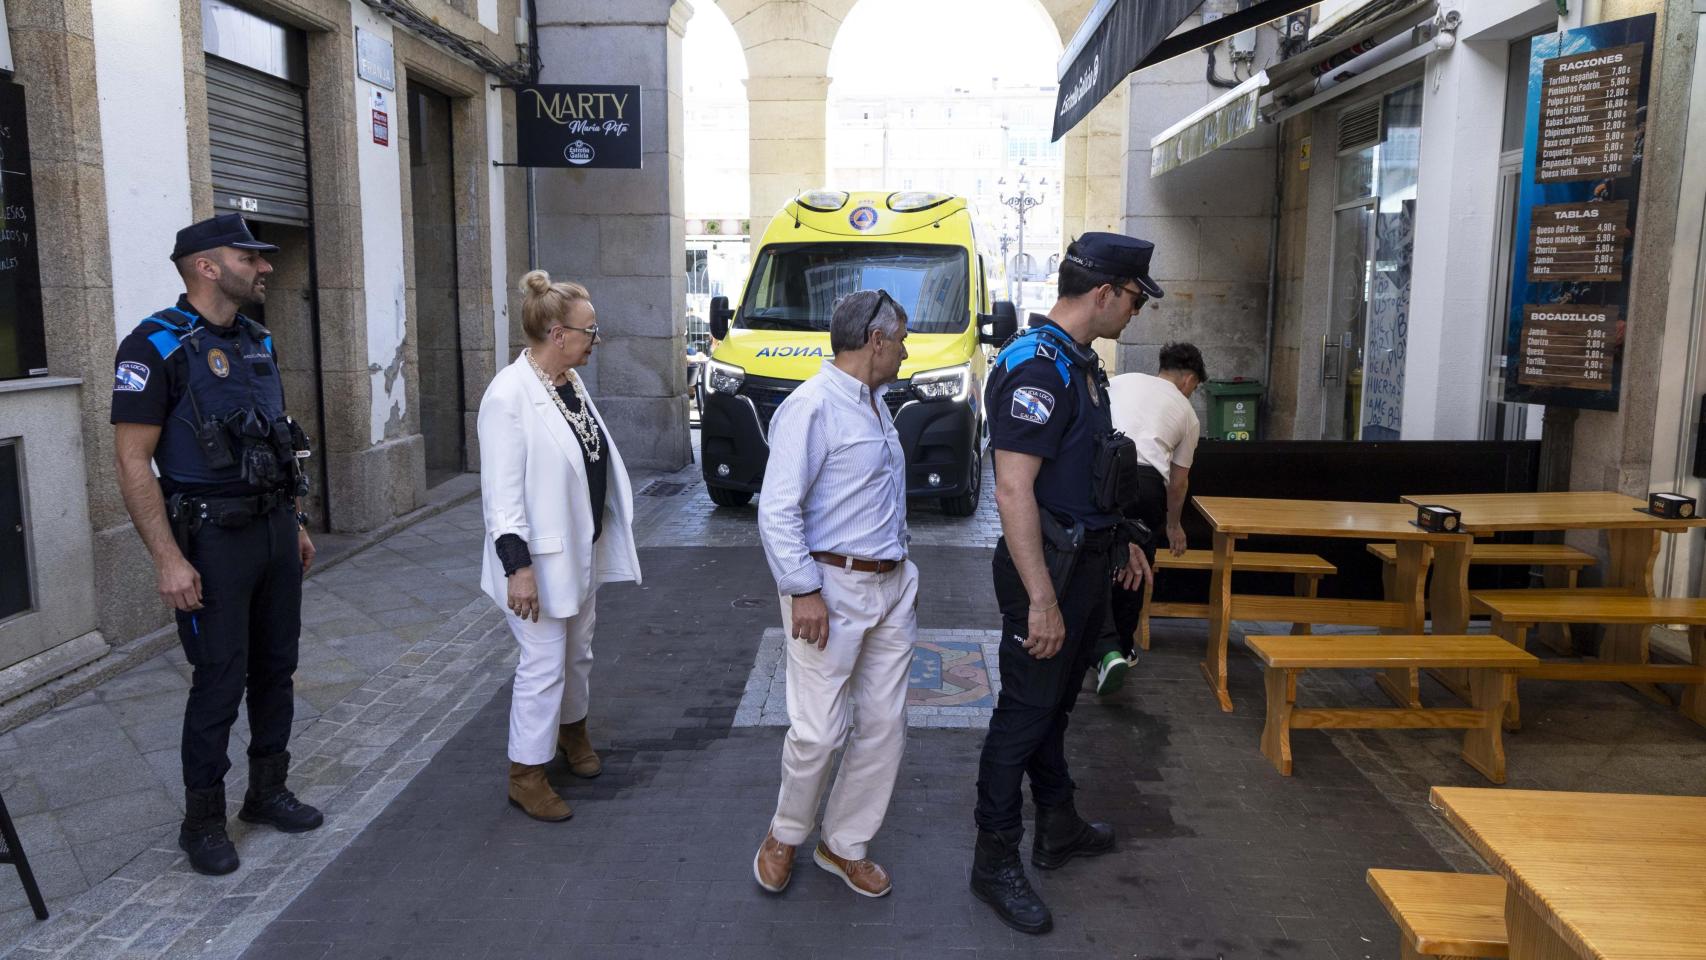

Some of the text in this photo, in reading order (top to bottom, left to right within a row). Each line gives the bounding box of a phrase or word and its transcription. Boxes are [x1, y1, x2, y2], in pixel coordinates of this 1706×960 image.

[1560, 54, 1623, 72] RACIONES
[1550, 76, 1569, 85] Tortilla
[1571, 70, 1599, 83] española
[1548, 85, 1577, 96] Pimientos
[522, 88, 628, 124] MARTY
[1548, 98, 1563, 107] Pulpo
[1570, 94, 1585, 103] Feira
[1570, 105, 1584, 114] Feira
[1546, 118, 1562, 127] Rabas
[1565, 115, 1589, 124] Calamar
[602, 120, 630, 136] Pita
[1545, 128, 1575, 138] Chipirones
[1544, 139, 1558, 147] Raxo
[1572, 135, 1595, 146] patatas
[1543, 148, 1572, 159] Croquetas
[1542, 158, 1571, 169] Empanada
[1574, 156, 1595, 166] Gallega
[1541, 170, 1559, 179] Queso
[1554, 210, 1599, 219] TABLAS
[1537, 226, 1554, 235] Queso
[1536, 236, 1553, 244] Queso
[1555, 235, 1585, 244] manchego
[1531, 313, 1606, 322] BOCADILLOS
[1527, 348, 1544, 356] Queso
